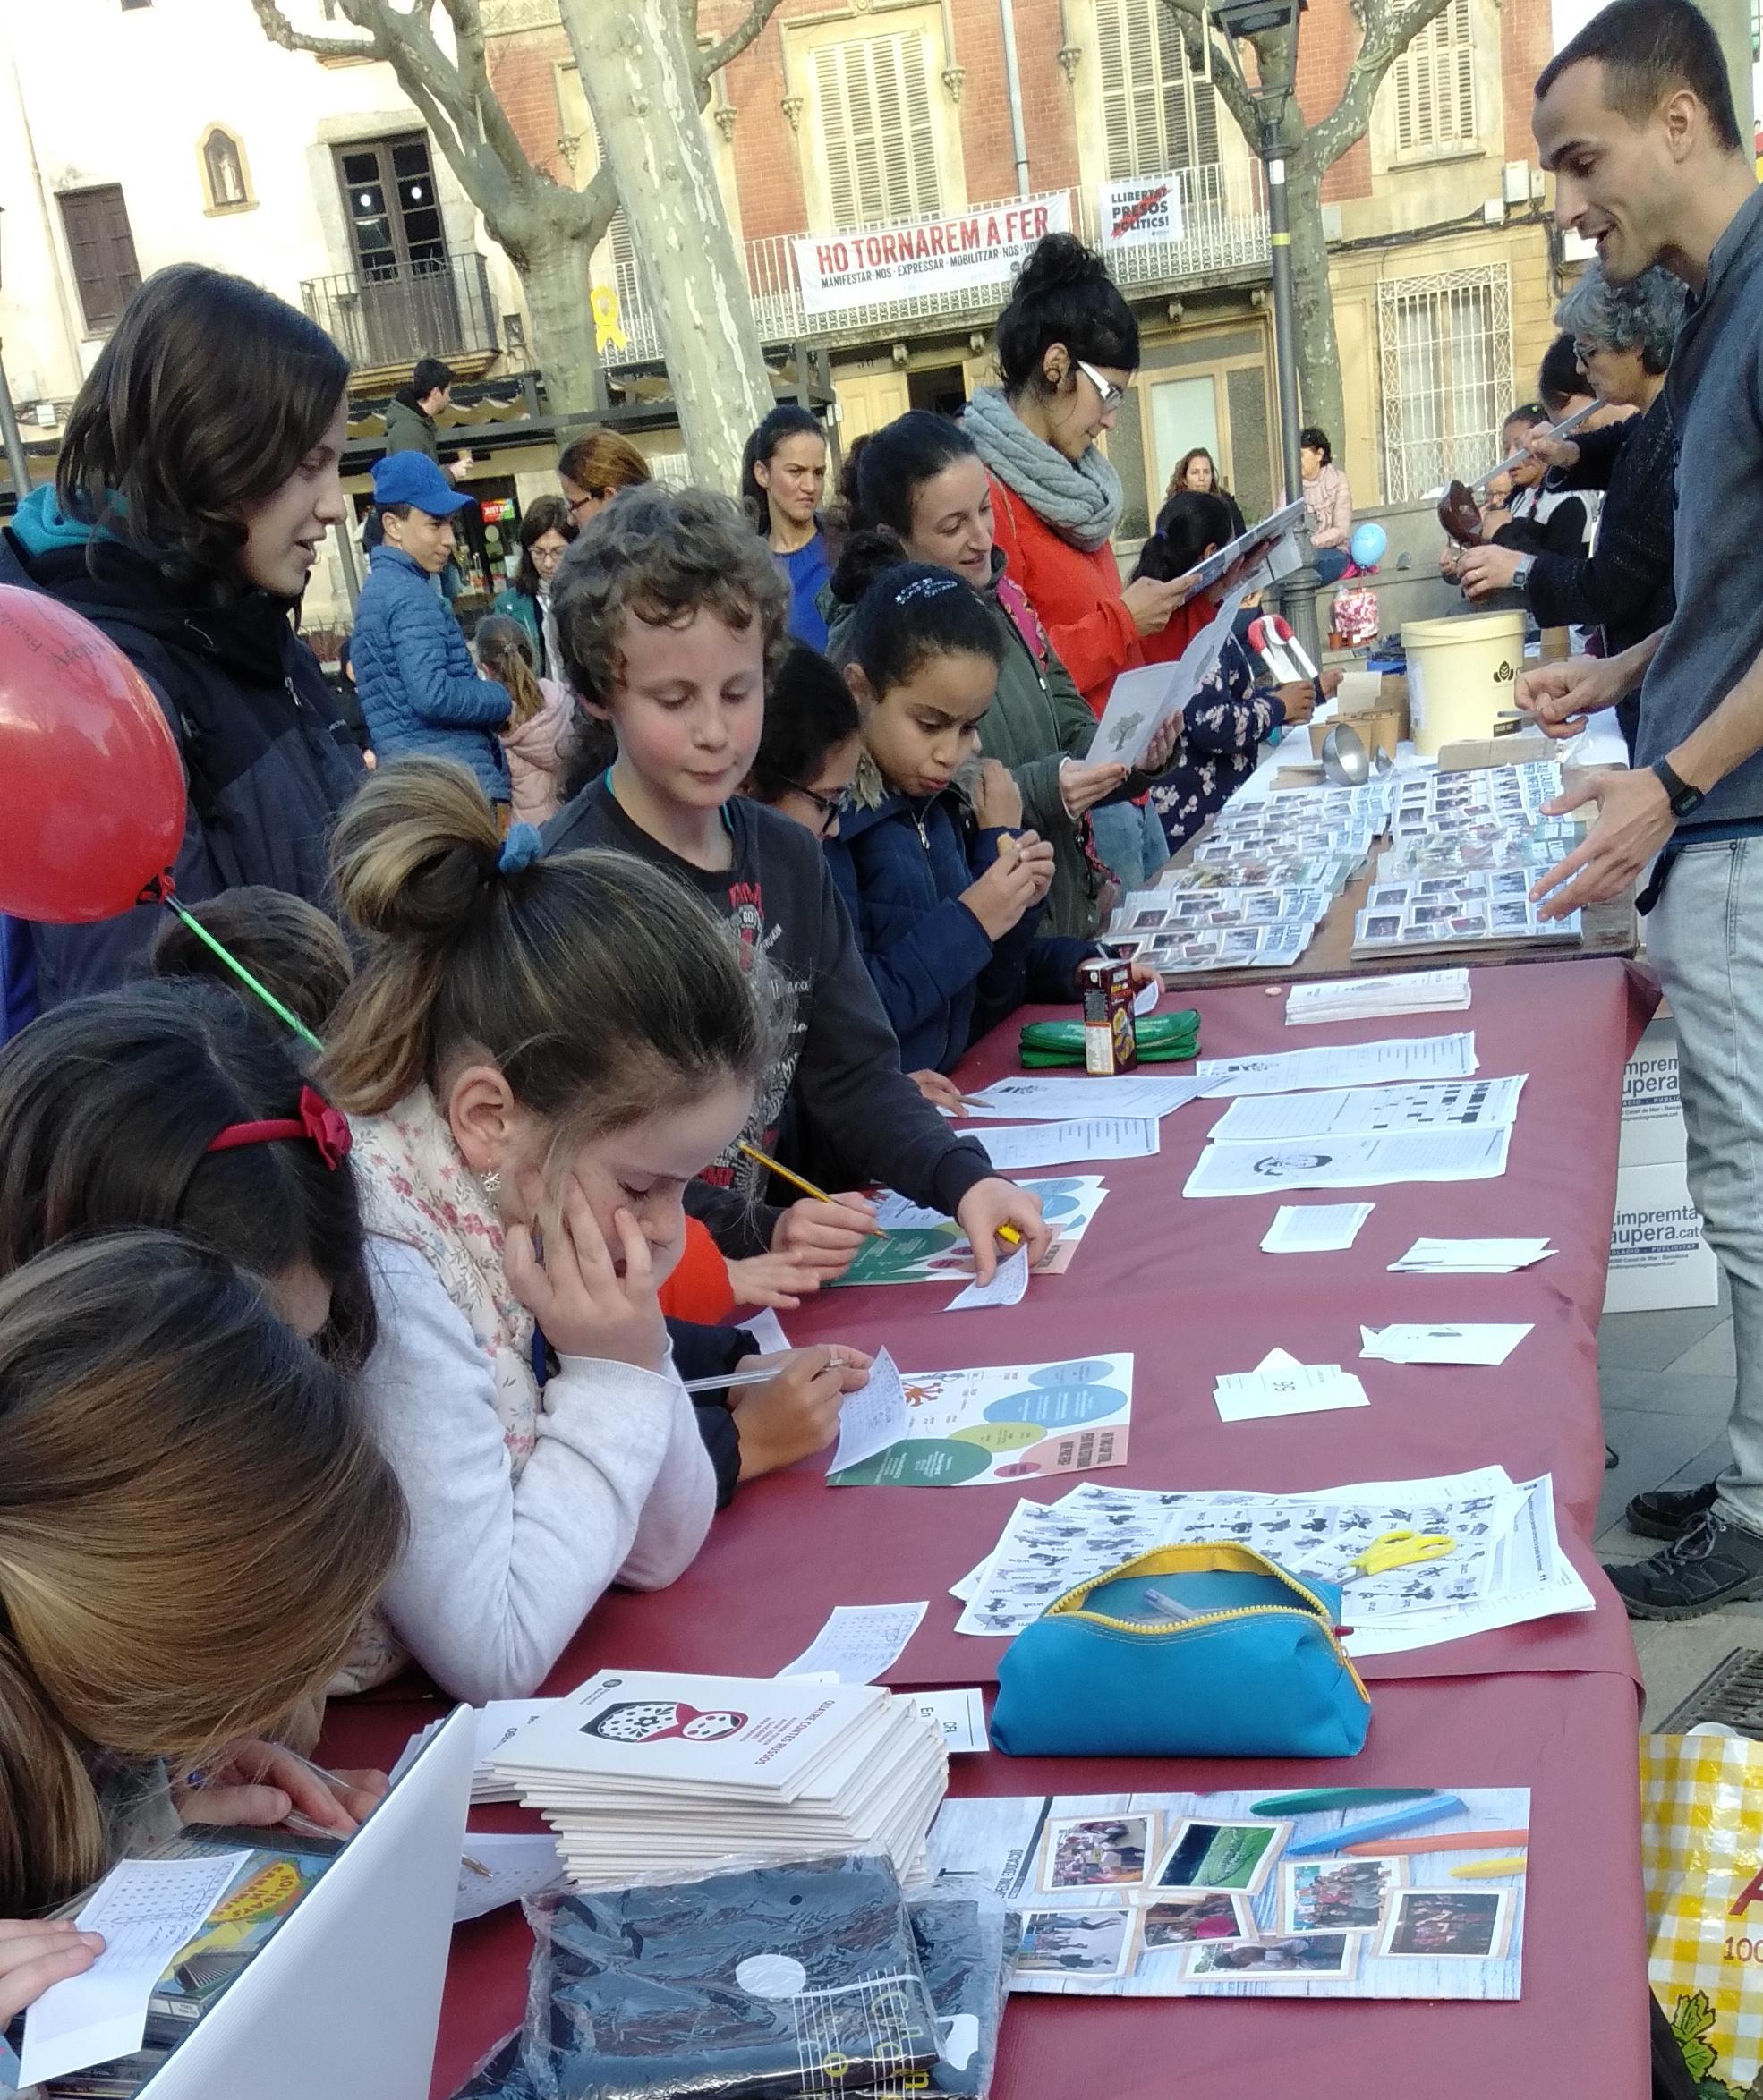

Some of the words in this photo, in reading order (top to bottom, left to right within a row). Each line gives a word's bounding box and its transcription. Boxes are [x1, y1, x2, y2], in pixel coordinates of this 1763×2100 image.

[1112, 201, 1168, 219] PRESOS
[816, 242, 849, 275] HO
[851, 219, 980, 268] TORNAREM
[986, 216, 1001, 246] A
[1006, 206, 1050, 243] FER
[898, 258, 944, 276] EXPRESSAR
[1651, 1244, 1696, 1253] PUBLICITAT
[781, 1721, 811, 1742] CONTES
[754, 1741, 787, 1764] RUSSOS
